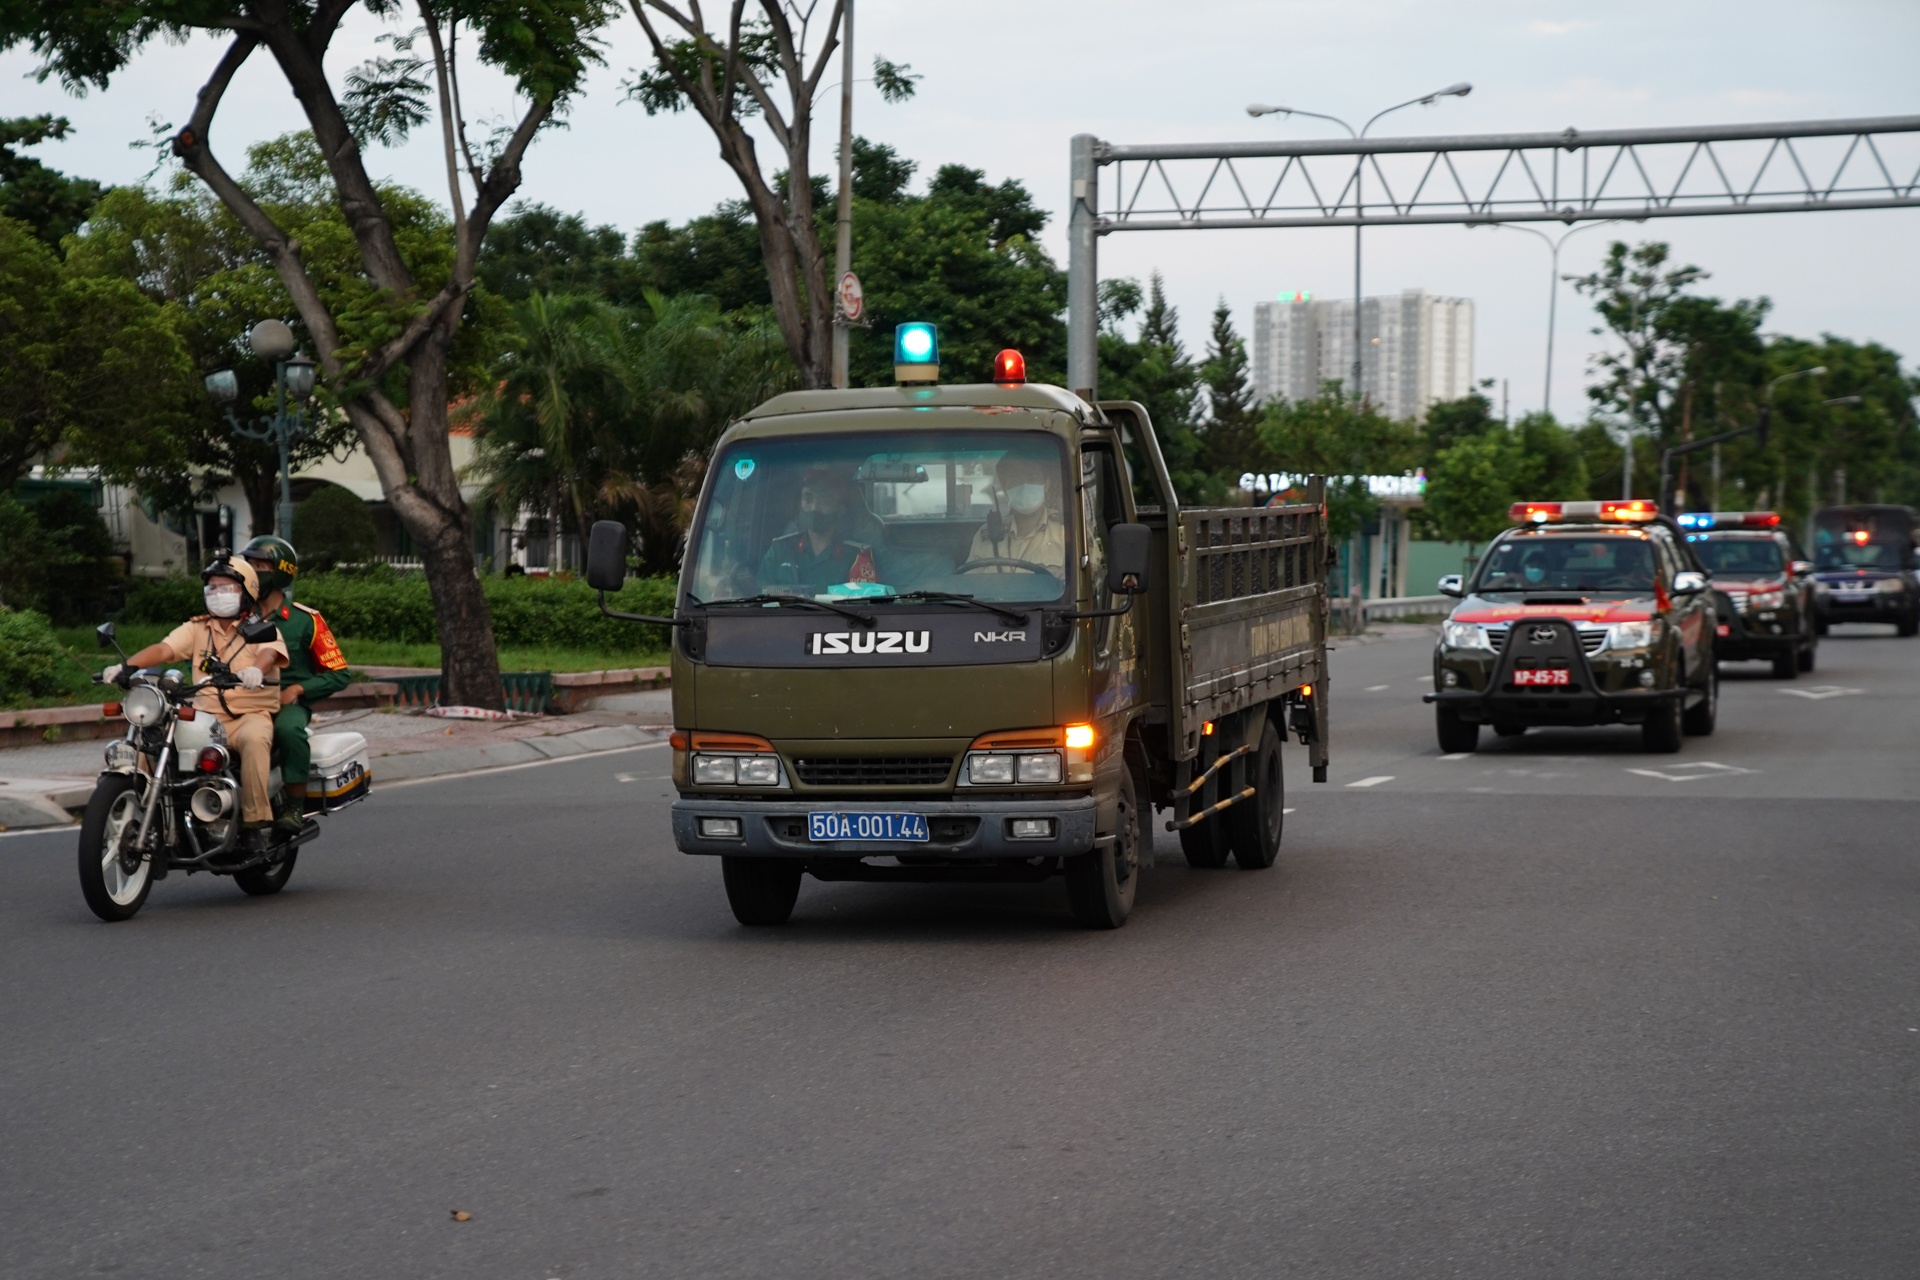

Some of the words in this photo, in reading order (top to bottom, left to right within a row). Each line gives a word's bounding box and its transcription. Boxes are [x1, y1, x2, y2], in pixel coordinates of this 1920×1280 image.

[812, 631, 930, 655] ISUZU
[974, 630, 1026, 643] NKR
[812, 815, 925, 838] 50A-001.44
